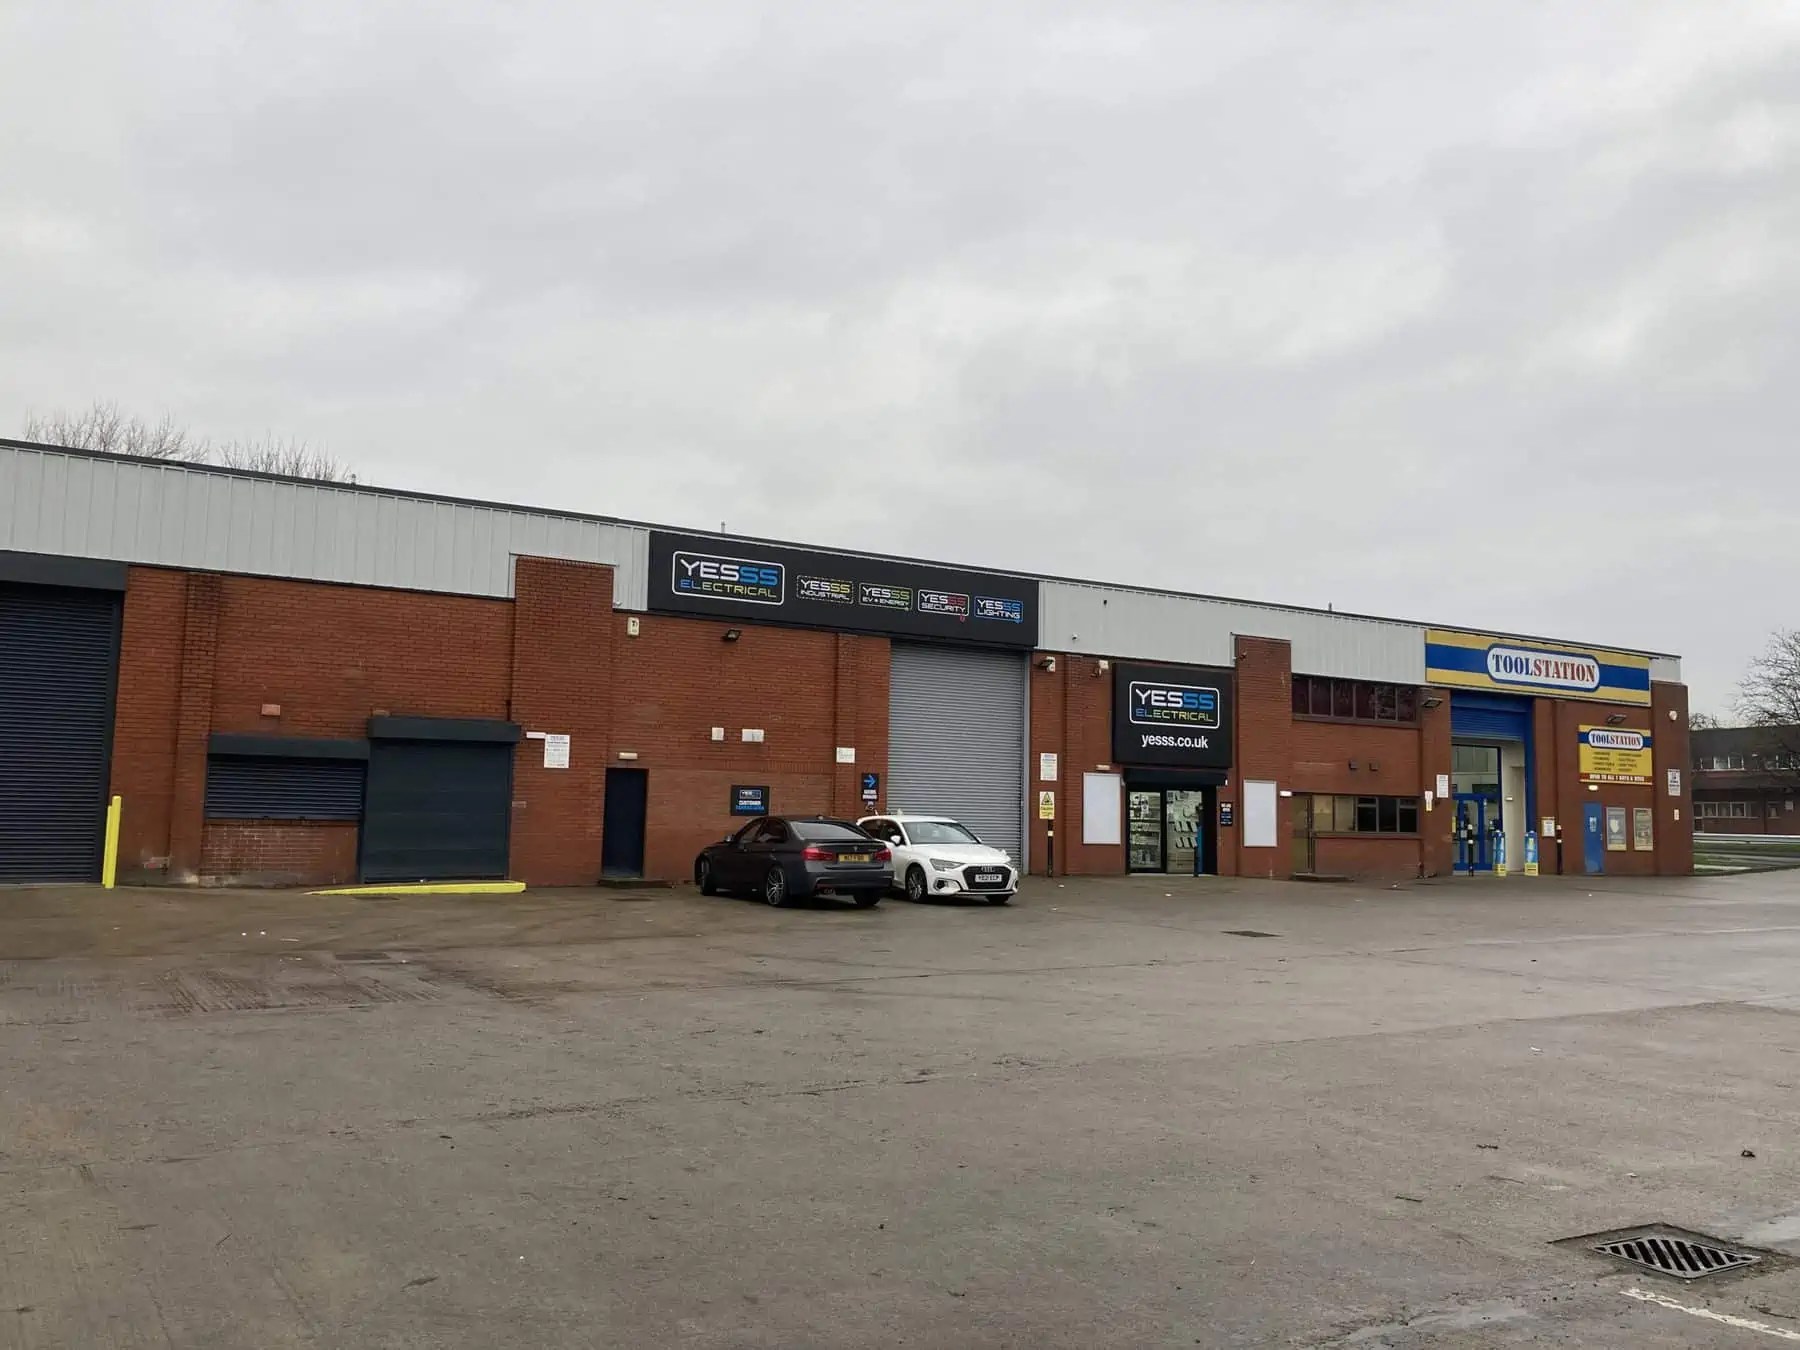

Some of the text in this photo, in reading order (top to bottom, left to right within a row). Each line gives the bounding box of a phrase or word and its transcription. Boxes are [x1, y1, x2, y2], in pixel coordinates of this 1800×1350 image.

[681, 559, 778, 586] YESSS
[680, 579, 777, 598] ELECTRICAL
[801, 579, 851, 594] YESSS
[862, 585, 910, 600] YESSS
[921, 593, 966, 607] YESSS
[921, 602, 966, 612] SECURITY
[978, 599, 1020, 612] YESSS
[977, 608, 1021, 619] LIGHTING
[1492, 653, 1595, 682] TOOLSTATION
[1135, 688, 1214, 710] YESSS
[1135, 708, 1214, 722] ELECTRICAL
[1141, 734, 1209, 749] yesss.co.uk
[1591, 733, 1641, 746] TOOLSTATION
